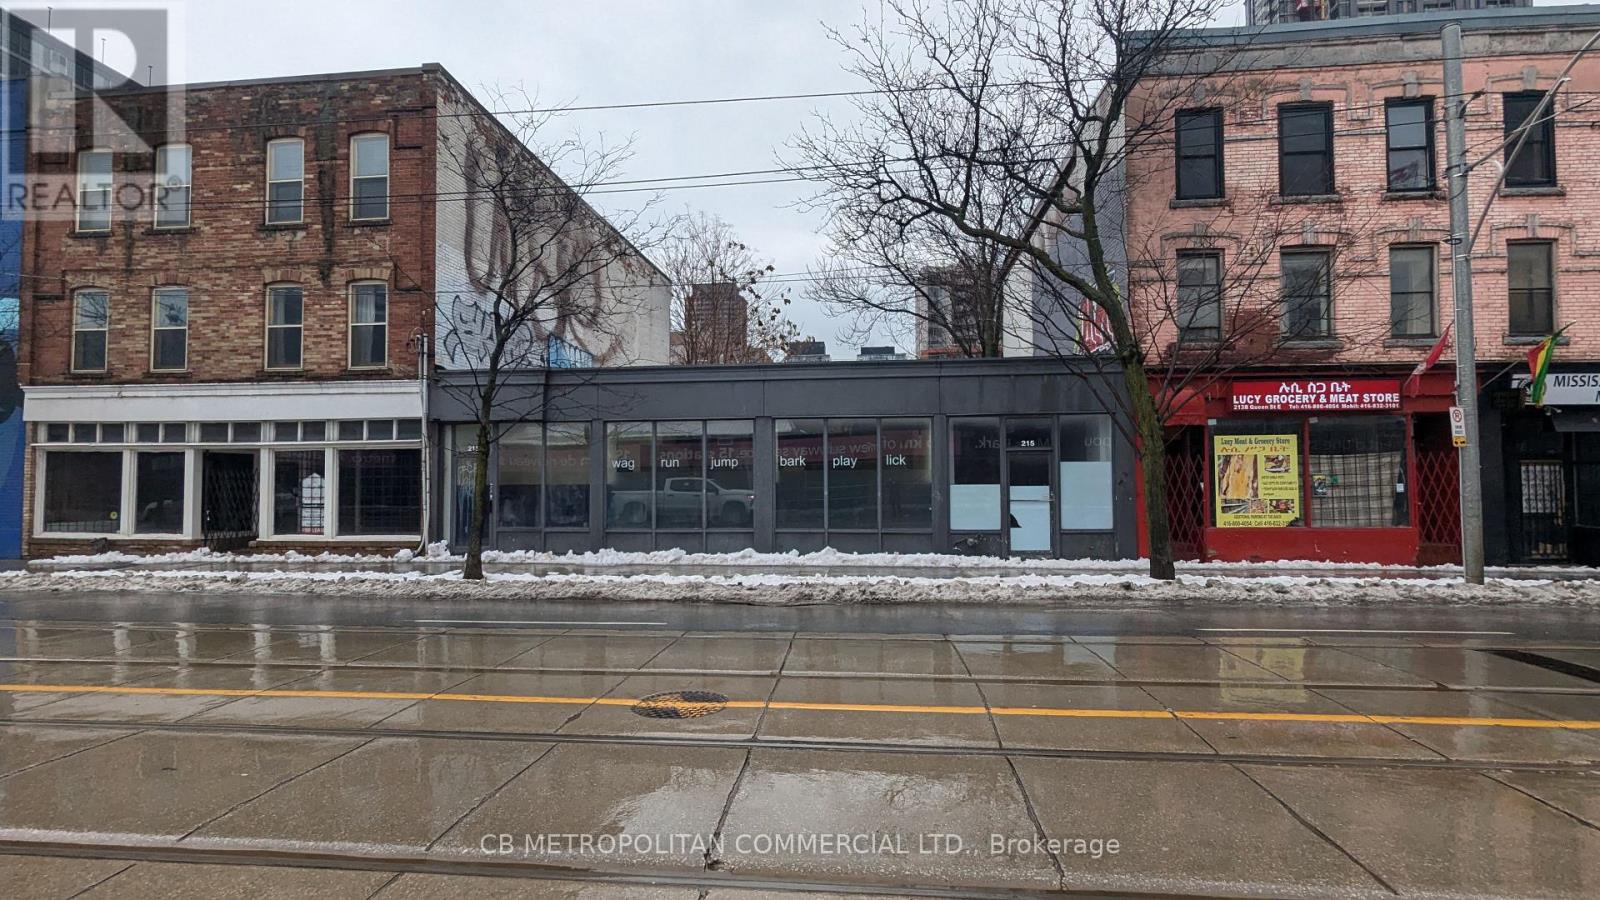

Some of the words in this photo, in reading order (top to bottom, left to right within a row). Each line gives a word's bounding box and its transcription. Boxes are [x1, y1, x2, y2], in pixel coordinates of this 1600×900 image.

[1553, 375, 1600, 388] MISSIS
[1233, 395, 1262, 404] LUCY
[1265, 394, 1317, 404] GROCERY
[1319, 394, 1328, 403] &
[1330, 393, 1360, 403] MEAT
[1363, 393, 1400, 403] STORE
[612, 459, 635, 470] wag
[660, 459, 680, 468] run
[710, 457, 739, 470] jump
[780, 455, 807, 467] bark
[832, 455, 858, 469] play
[886, 454, 906, 466] lick
